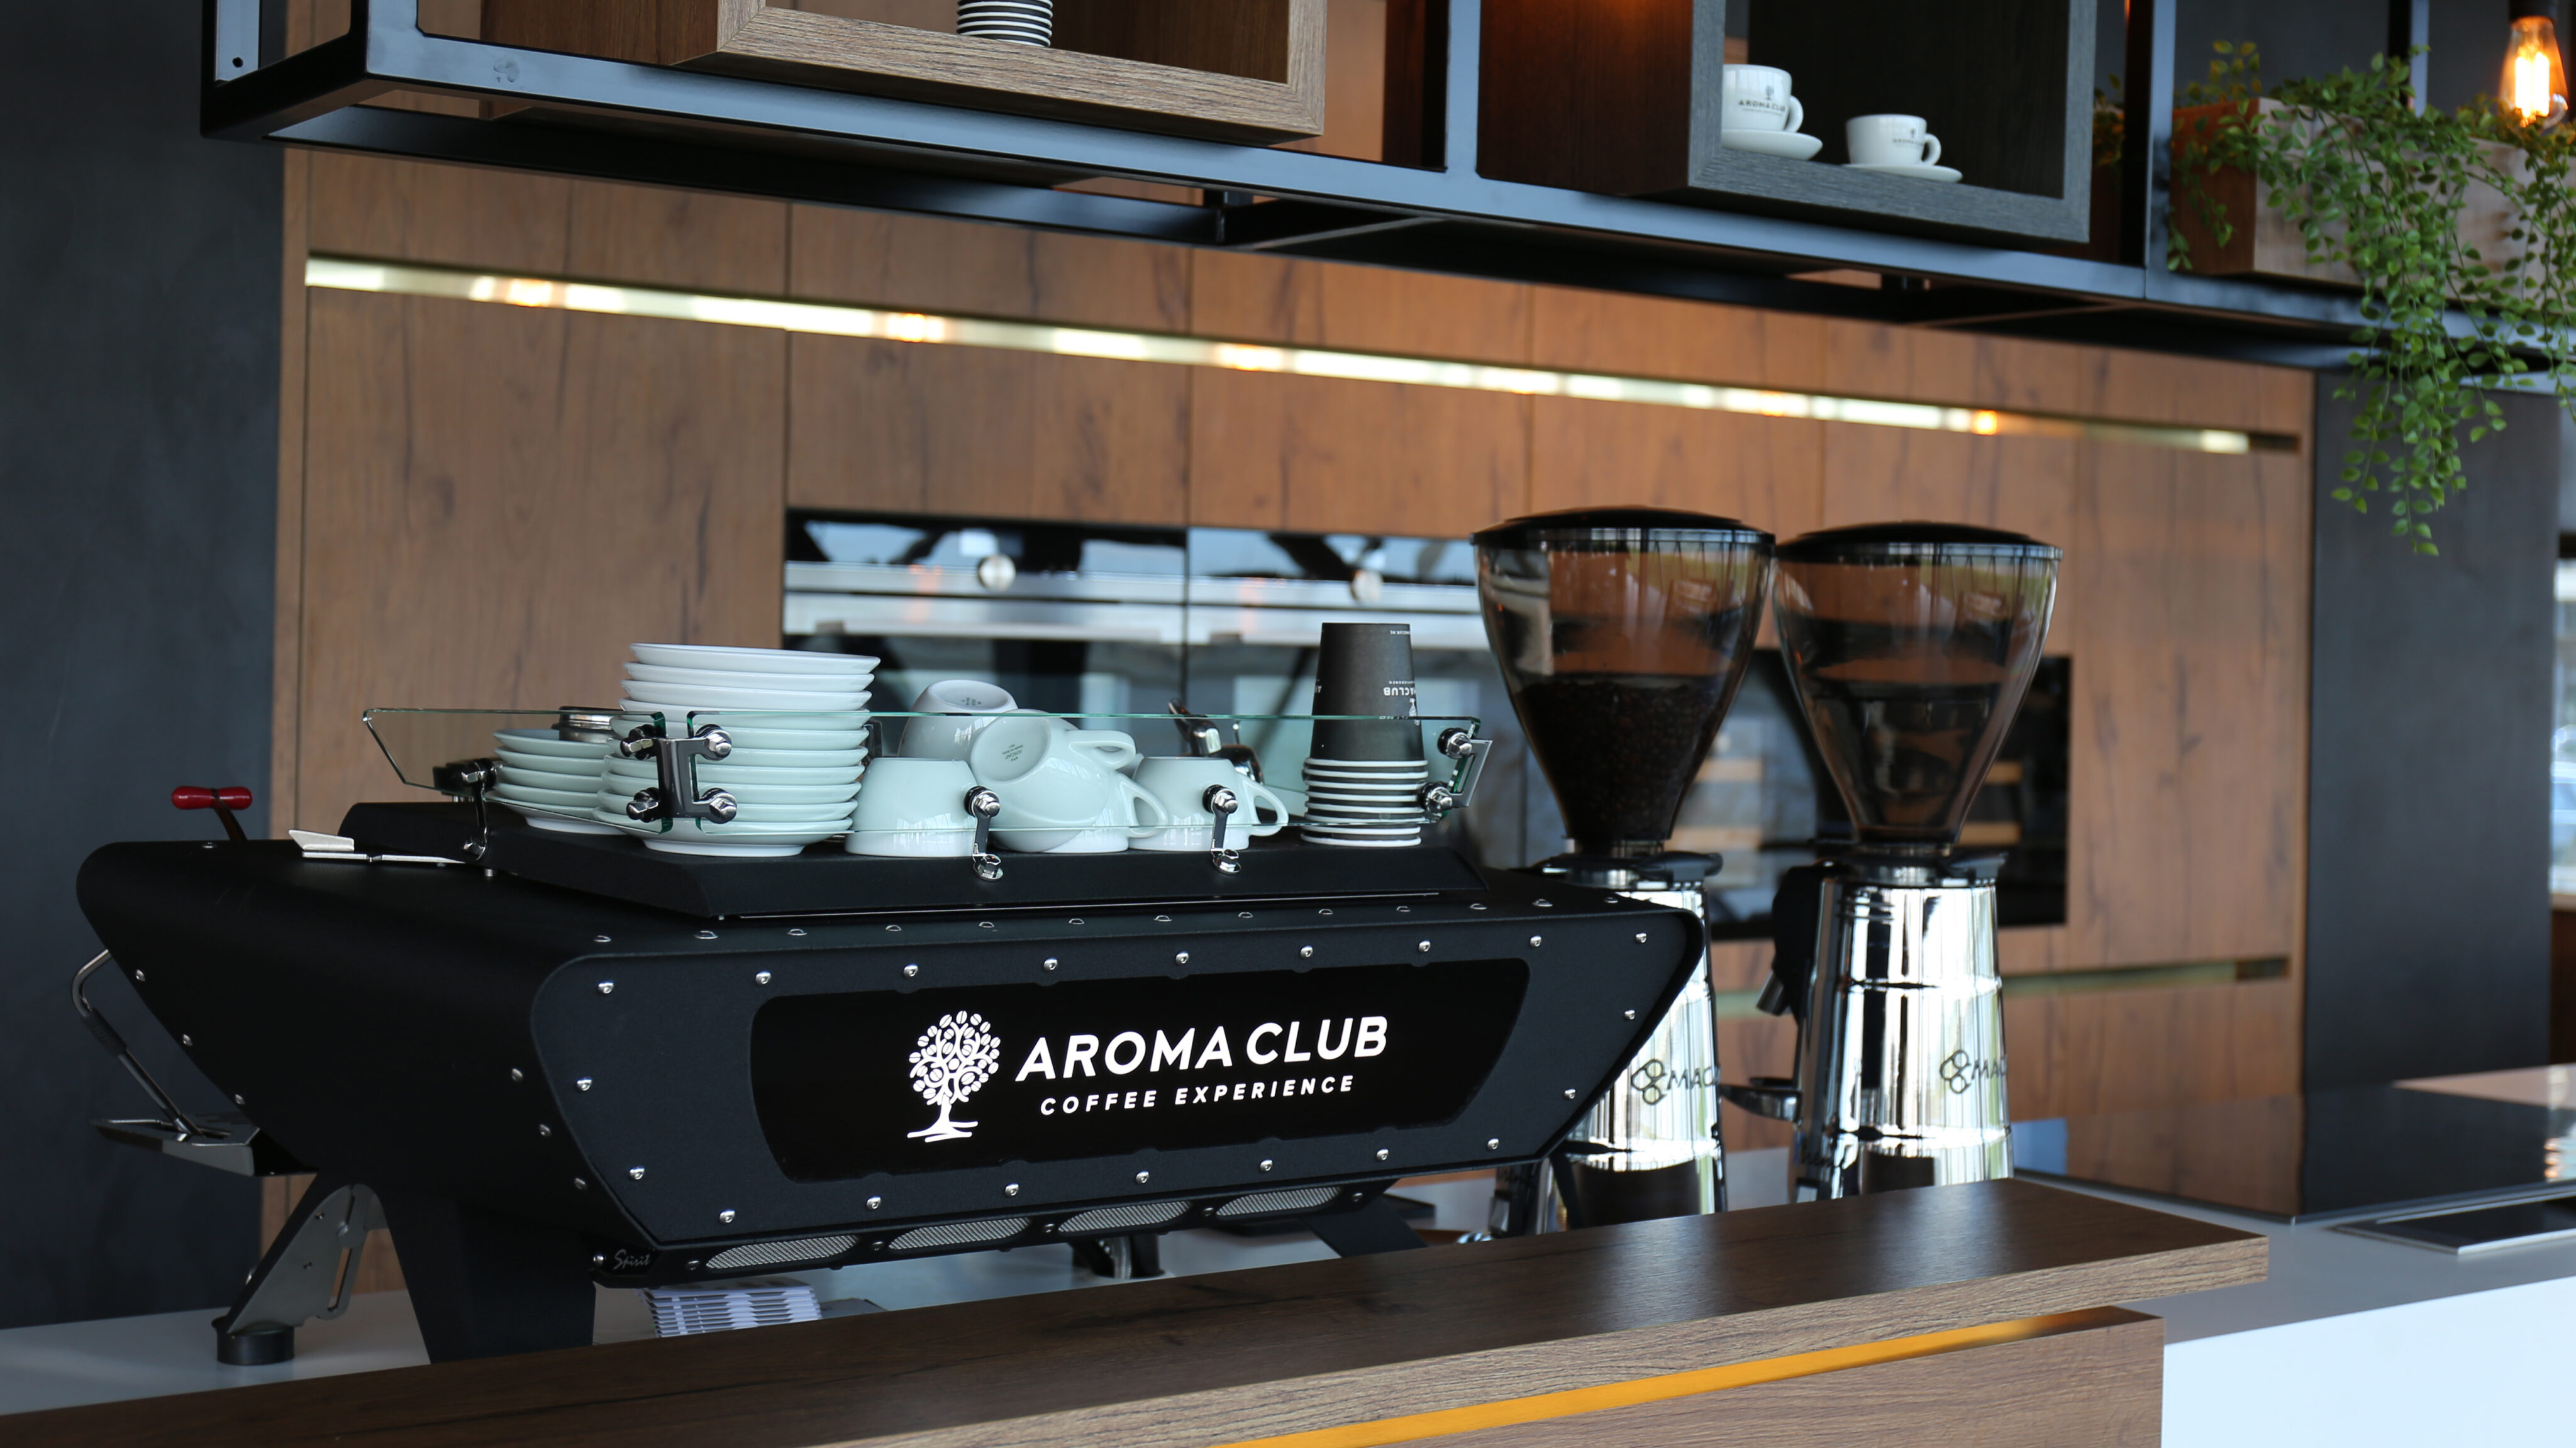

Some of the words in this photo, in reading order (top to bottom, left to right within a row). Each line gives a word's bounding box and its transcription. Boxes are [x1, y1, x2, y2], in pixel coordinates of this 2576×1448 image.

[1014, 1025, 1233, 1082] AROMA
[1246, 1015, 1387, 1065] CLUB
[1040, 1090, 1157, 1115] COFFEE
[1175, 1075, 1353, 1105] EXPERIENCE
[613, 1249, 651, 1270] Spirit
